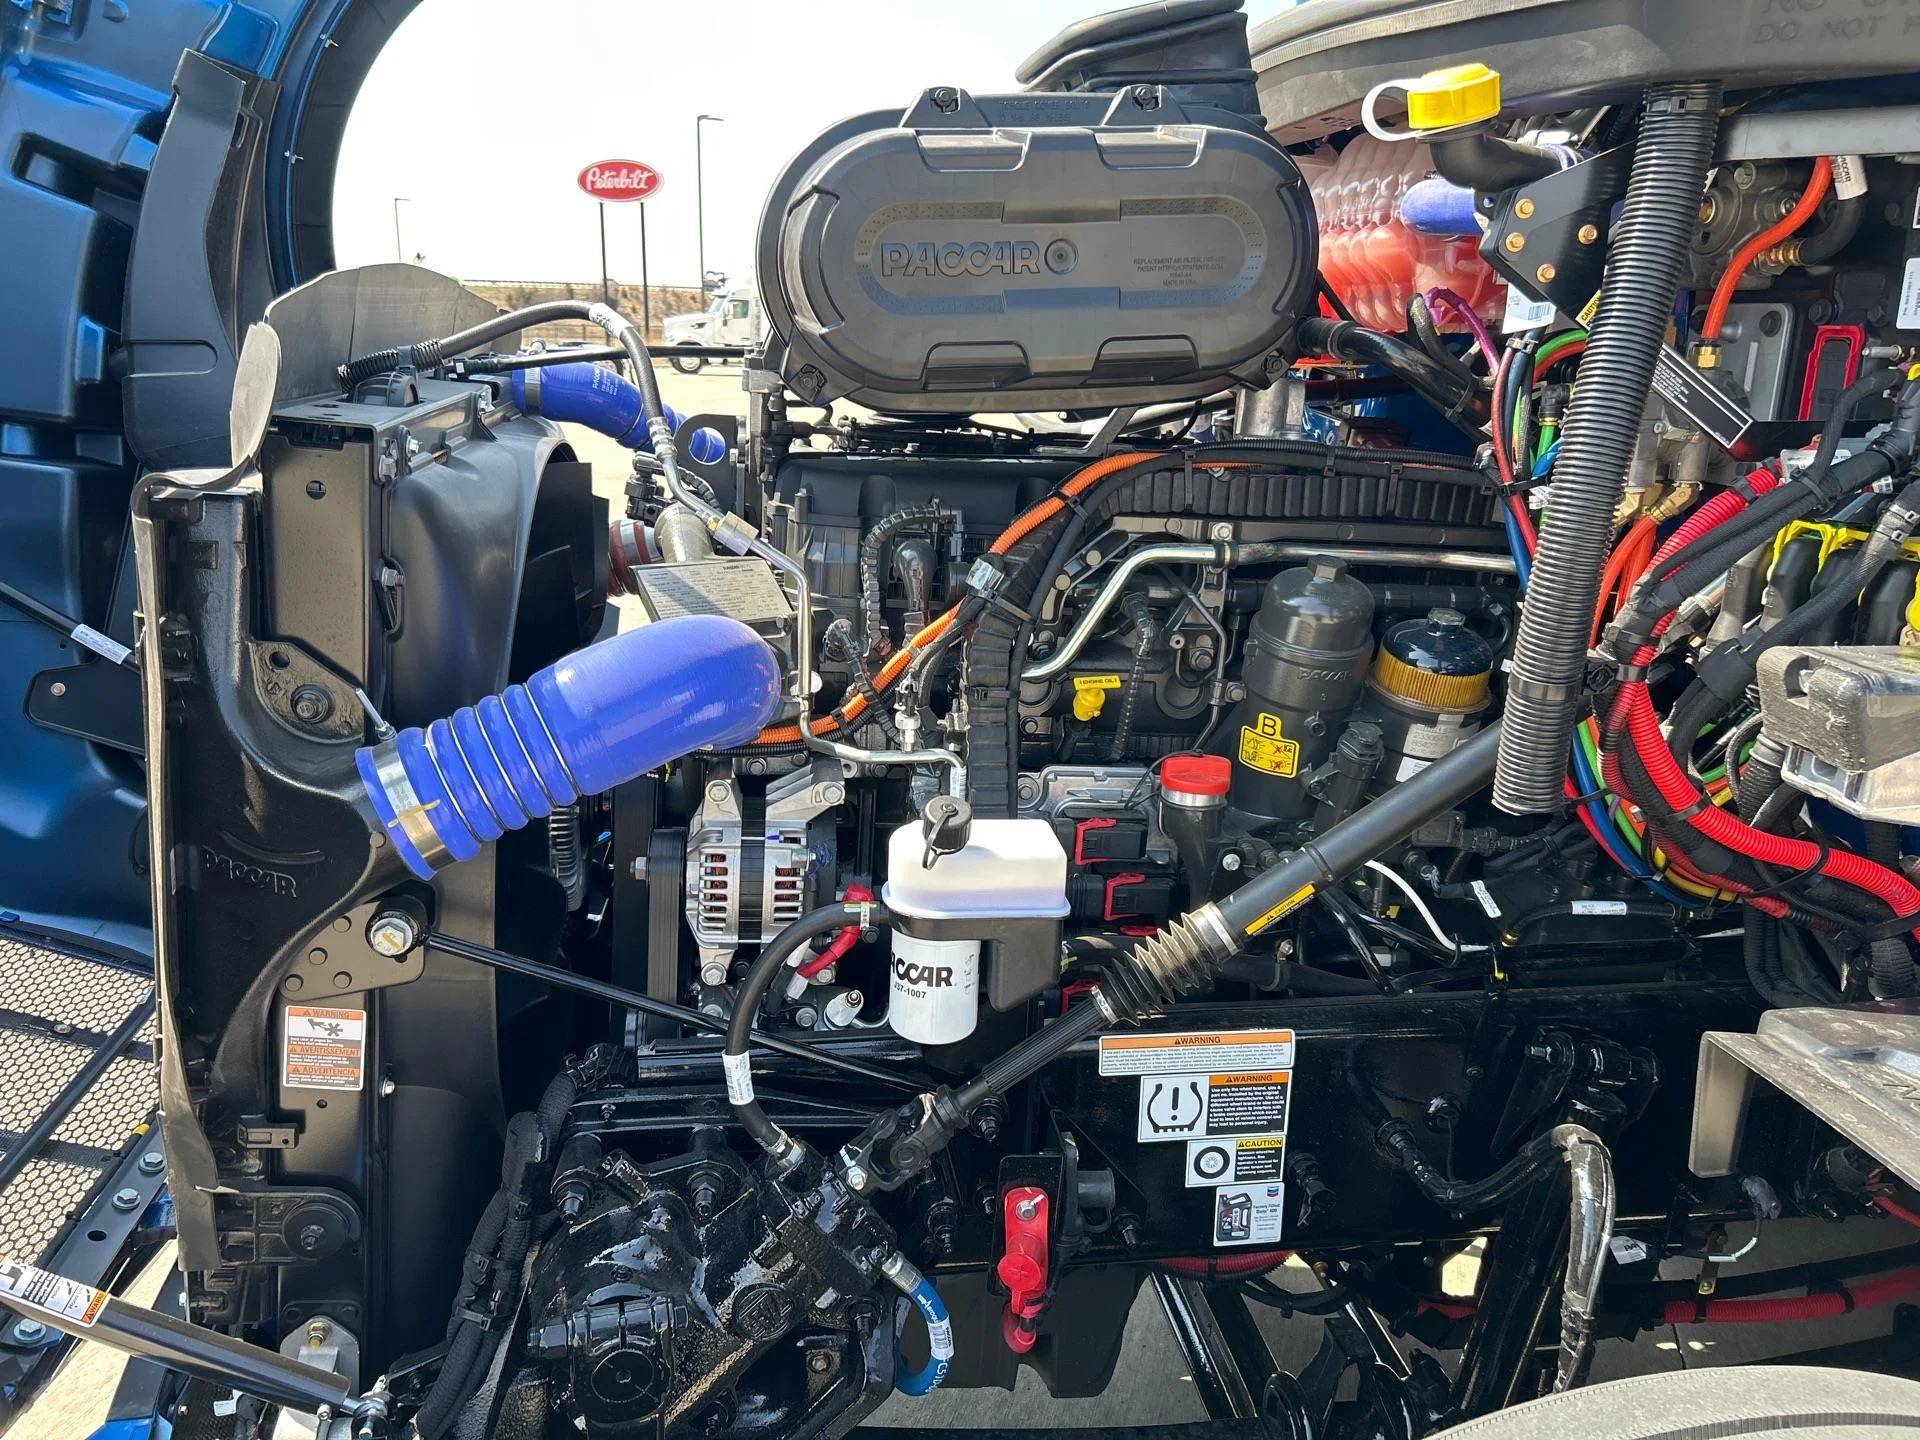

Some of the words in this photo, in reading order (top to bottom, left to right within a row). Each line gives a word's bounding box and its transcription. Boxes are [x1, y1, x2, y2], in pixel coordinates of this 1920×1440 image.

[586, 167, 654, 191] Peterbilt
[881, 240, 1040, 278] PACCAR
[1262, 716, 1277, 737] B
[1274, 899, 1296, 915] CAUTION
[891, 951, 953, 988] ACCAR
[313, 1009, 349, 1019] WARNING
[1180, 1036, 1221, 1045] WARNING
[300, 1047, 360, 1057] AVERTISSEMENT
[303, 1066, 355, 1076] ADVERTENCIA
[1233, 1074, 1273, 1082] WARNING
[1245, 1139, 1282, 1148] CAUTION
